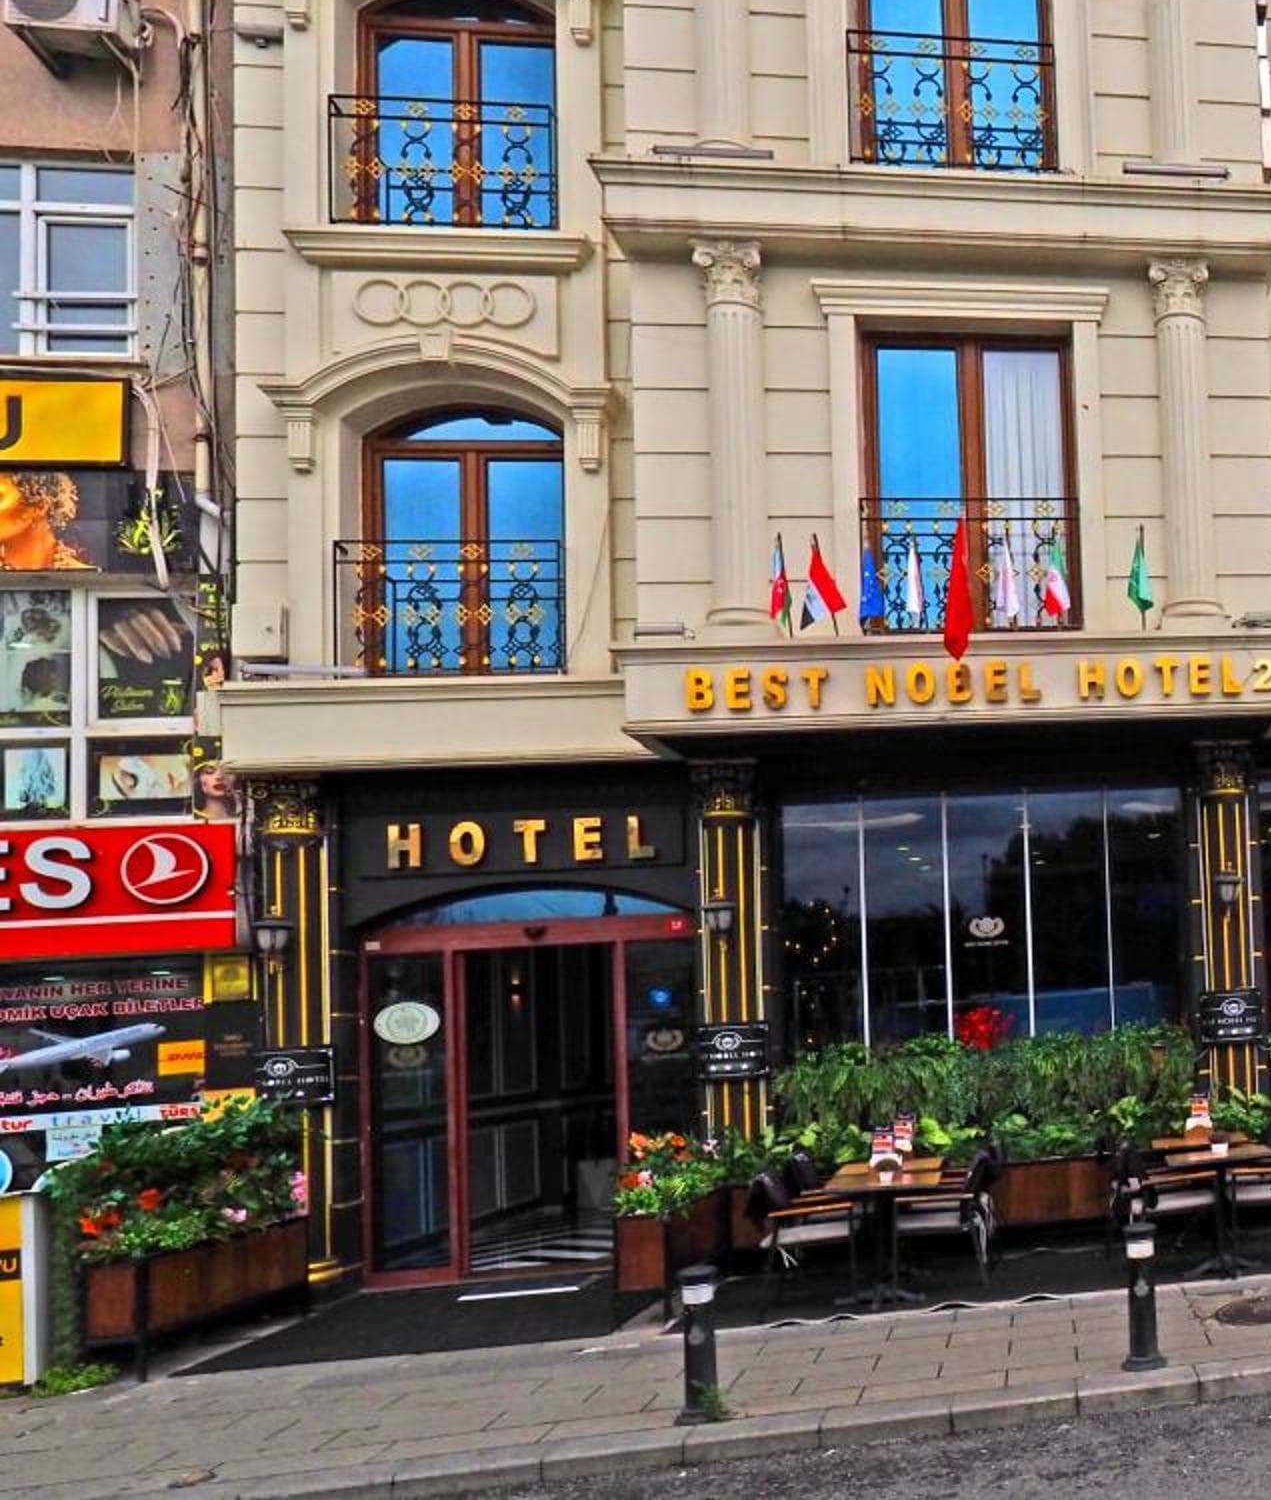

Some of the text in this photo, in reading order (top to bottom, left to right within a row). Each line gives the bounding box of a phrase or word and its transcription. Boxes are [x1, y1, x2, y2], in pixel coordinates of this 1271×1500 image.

[685, 665, 829, 712] BEST
[865, 660, 1042, 707] NOBEL
[1078, 656, 1244, 699] HOTEL
[385, 814, 656, 870] HOTEL
[71, 980, 113, 997] HER
[51, 1002, 108, 1020] UÇAK
